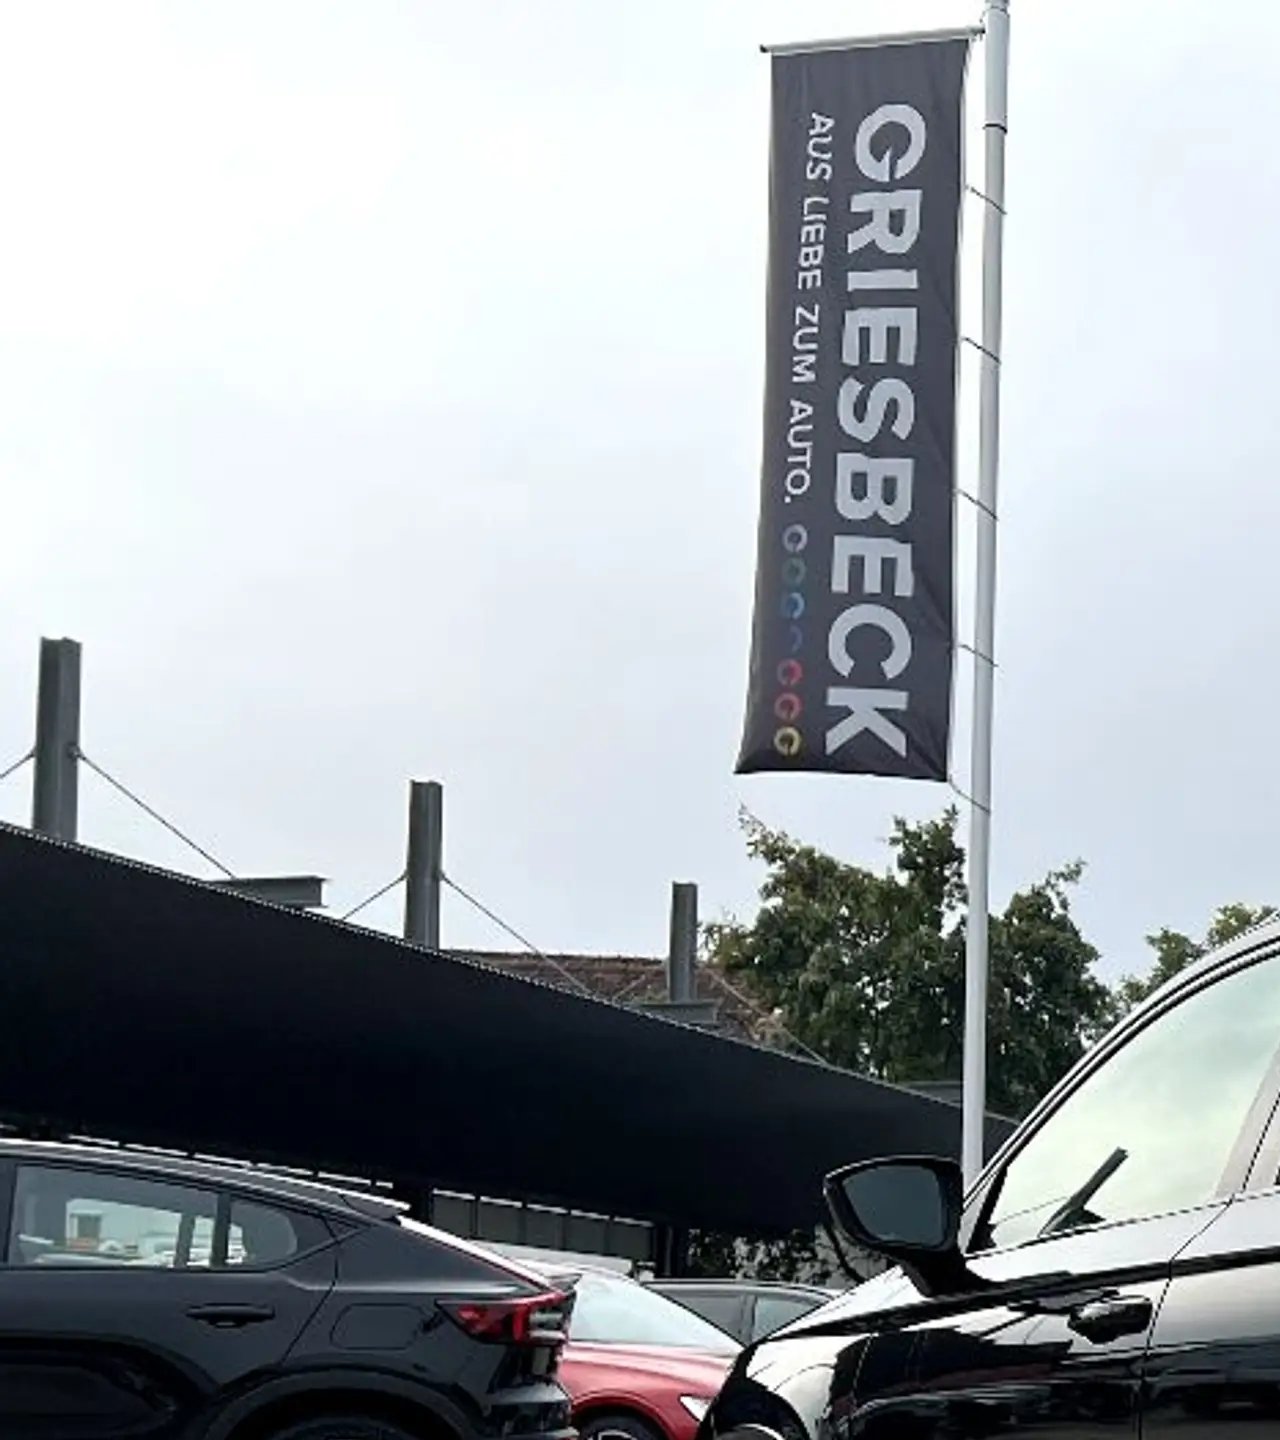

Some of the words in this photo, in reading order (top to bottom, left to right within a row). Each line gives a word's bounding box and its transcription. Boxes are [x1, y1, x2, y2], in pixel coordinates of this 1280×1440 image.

[805, 112, 836, 182] AUS
[798, 196, 830, 290] LIEBE
[792, 303, 820, 384] ZUM
[784, 399, 814, 504] AUTO.
[825, 103, 926, 758] GRIESBECK
